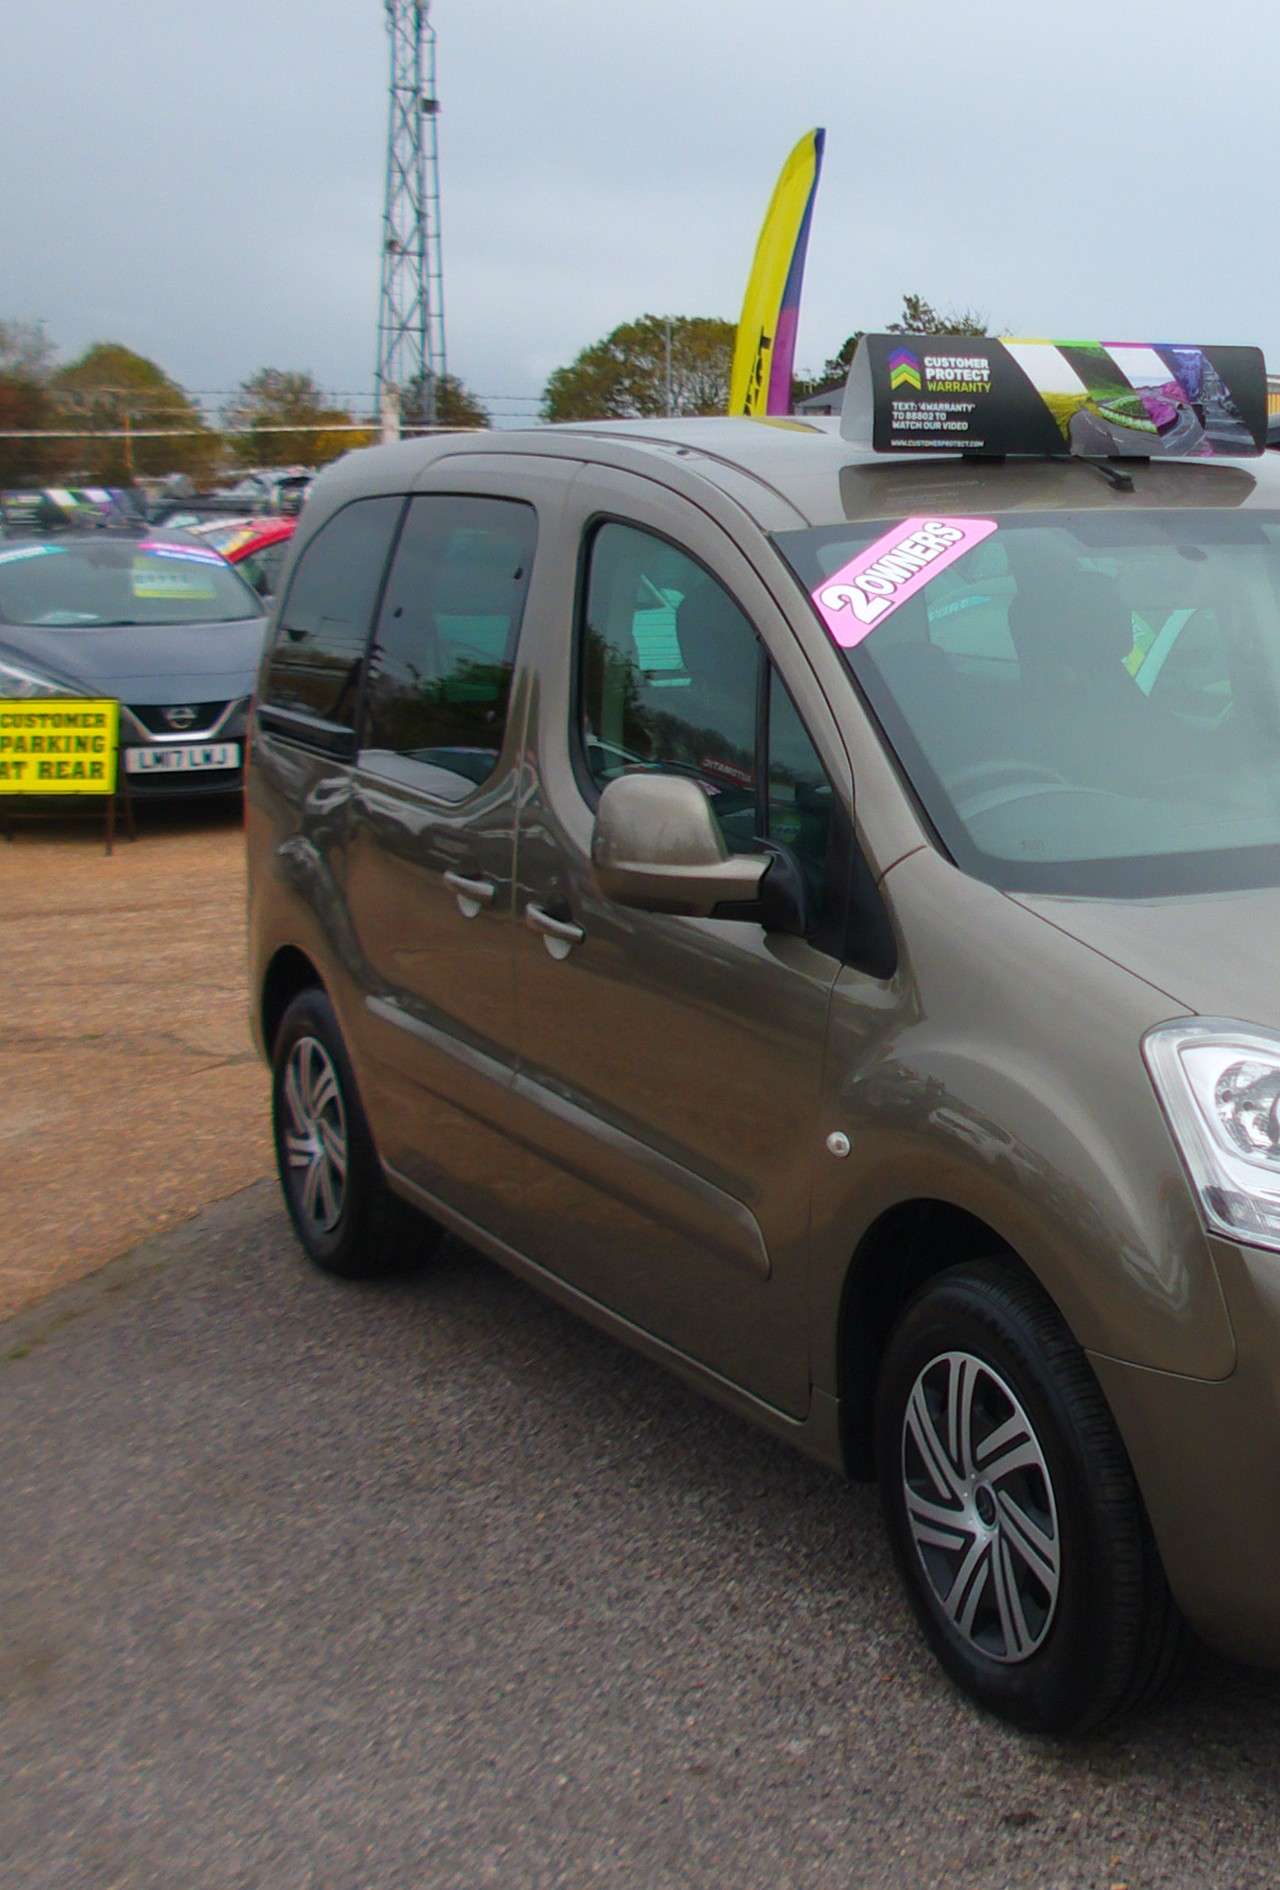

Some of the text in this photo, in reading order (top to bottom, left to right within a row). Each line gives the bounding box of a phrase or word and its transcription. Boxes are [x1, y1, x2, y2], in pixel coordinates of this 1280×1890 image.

[923, 356, 990, 369] CUSTOMER
[925, 367, 991, 382] PROTECT
[927, 381, 992, 393] WARRANTY
[891, 411, 905, 420] TO
[935, 412, 947, 421] TO
[891, 420, 969, 431] WATCH OUR VIDEO
[853, 521, 966, 596] OWNERS
[0, 713, 105, 729] CUSTOMER
[0, 735, 105, 754] PARKING
[37, 760, 105, 780] REAR
